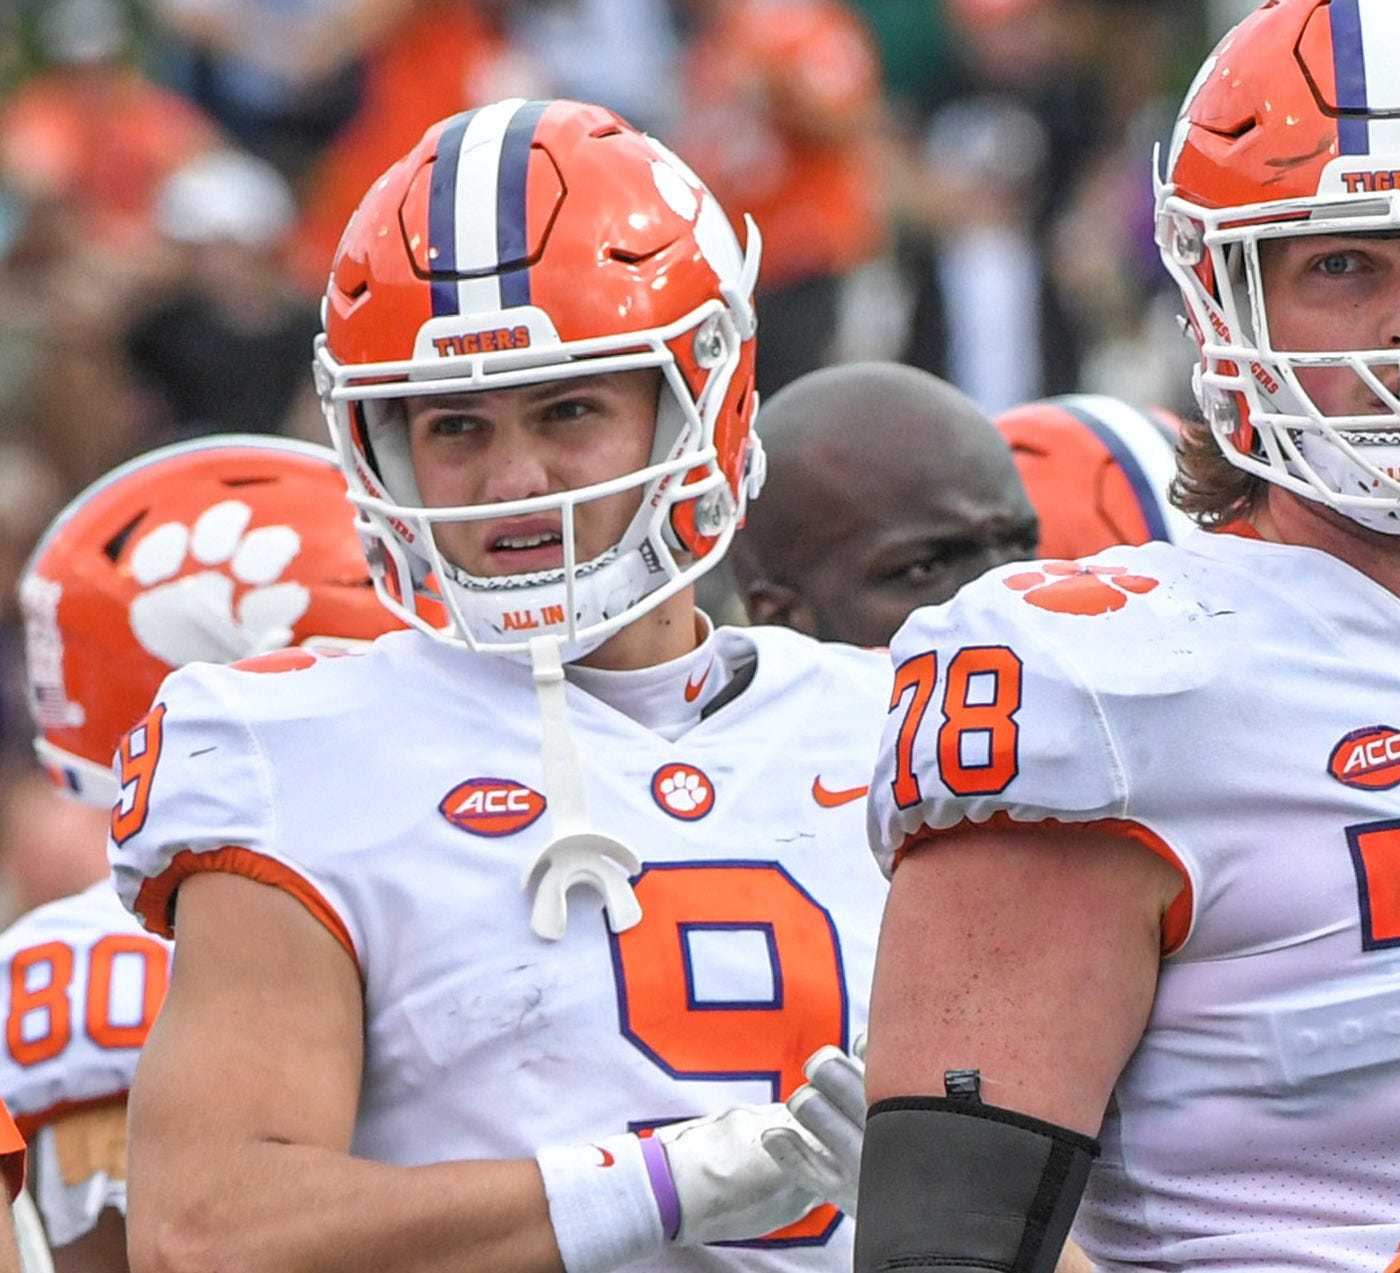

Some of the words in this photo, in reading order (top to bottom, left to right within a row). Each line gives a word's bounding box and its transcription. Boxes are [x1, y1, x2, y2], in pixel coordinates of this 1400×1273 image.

[433, 325, 531, 358] TIGERS
[1249, 361, 1280, 395] GERS
[502, 609, 539, 631] ALL
[541, 604, 566, 626] IN
[888, 645, 1024, 811] 78
[111, 702, 168, 849] 9
[454, 788, 531, 815] ACC
[6, 932, 171, 1069] 80
[603, 859, 849, 1248] 9
